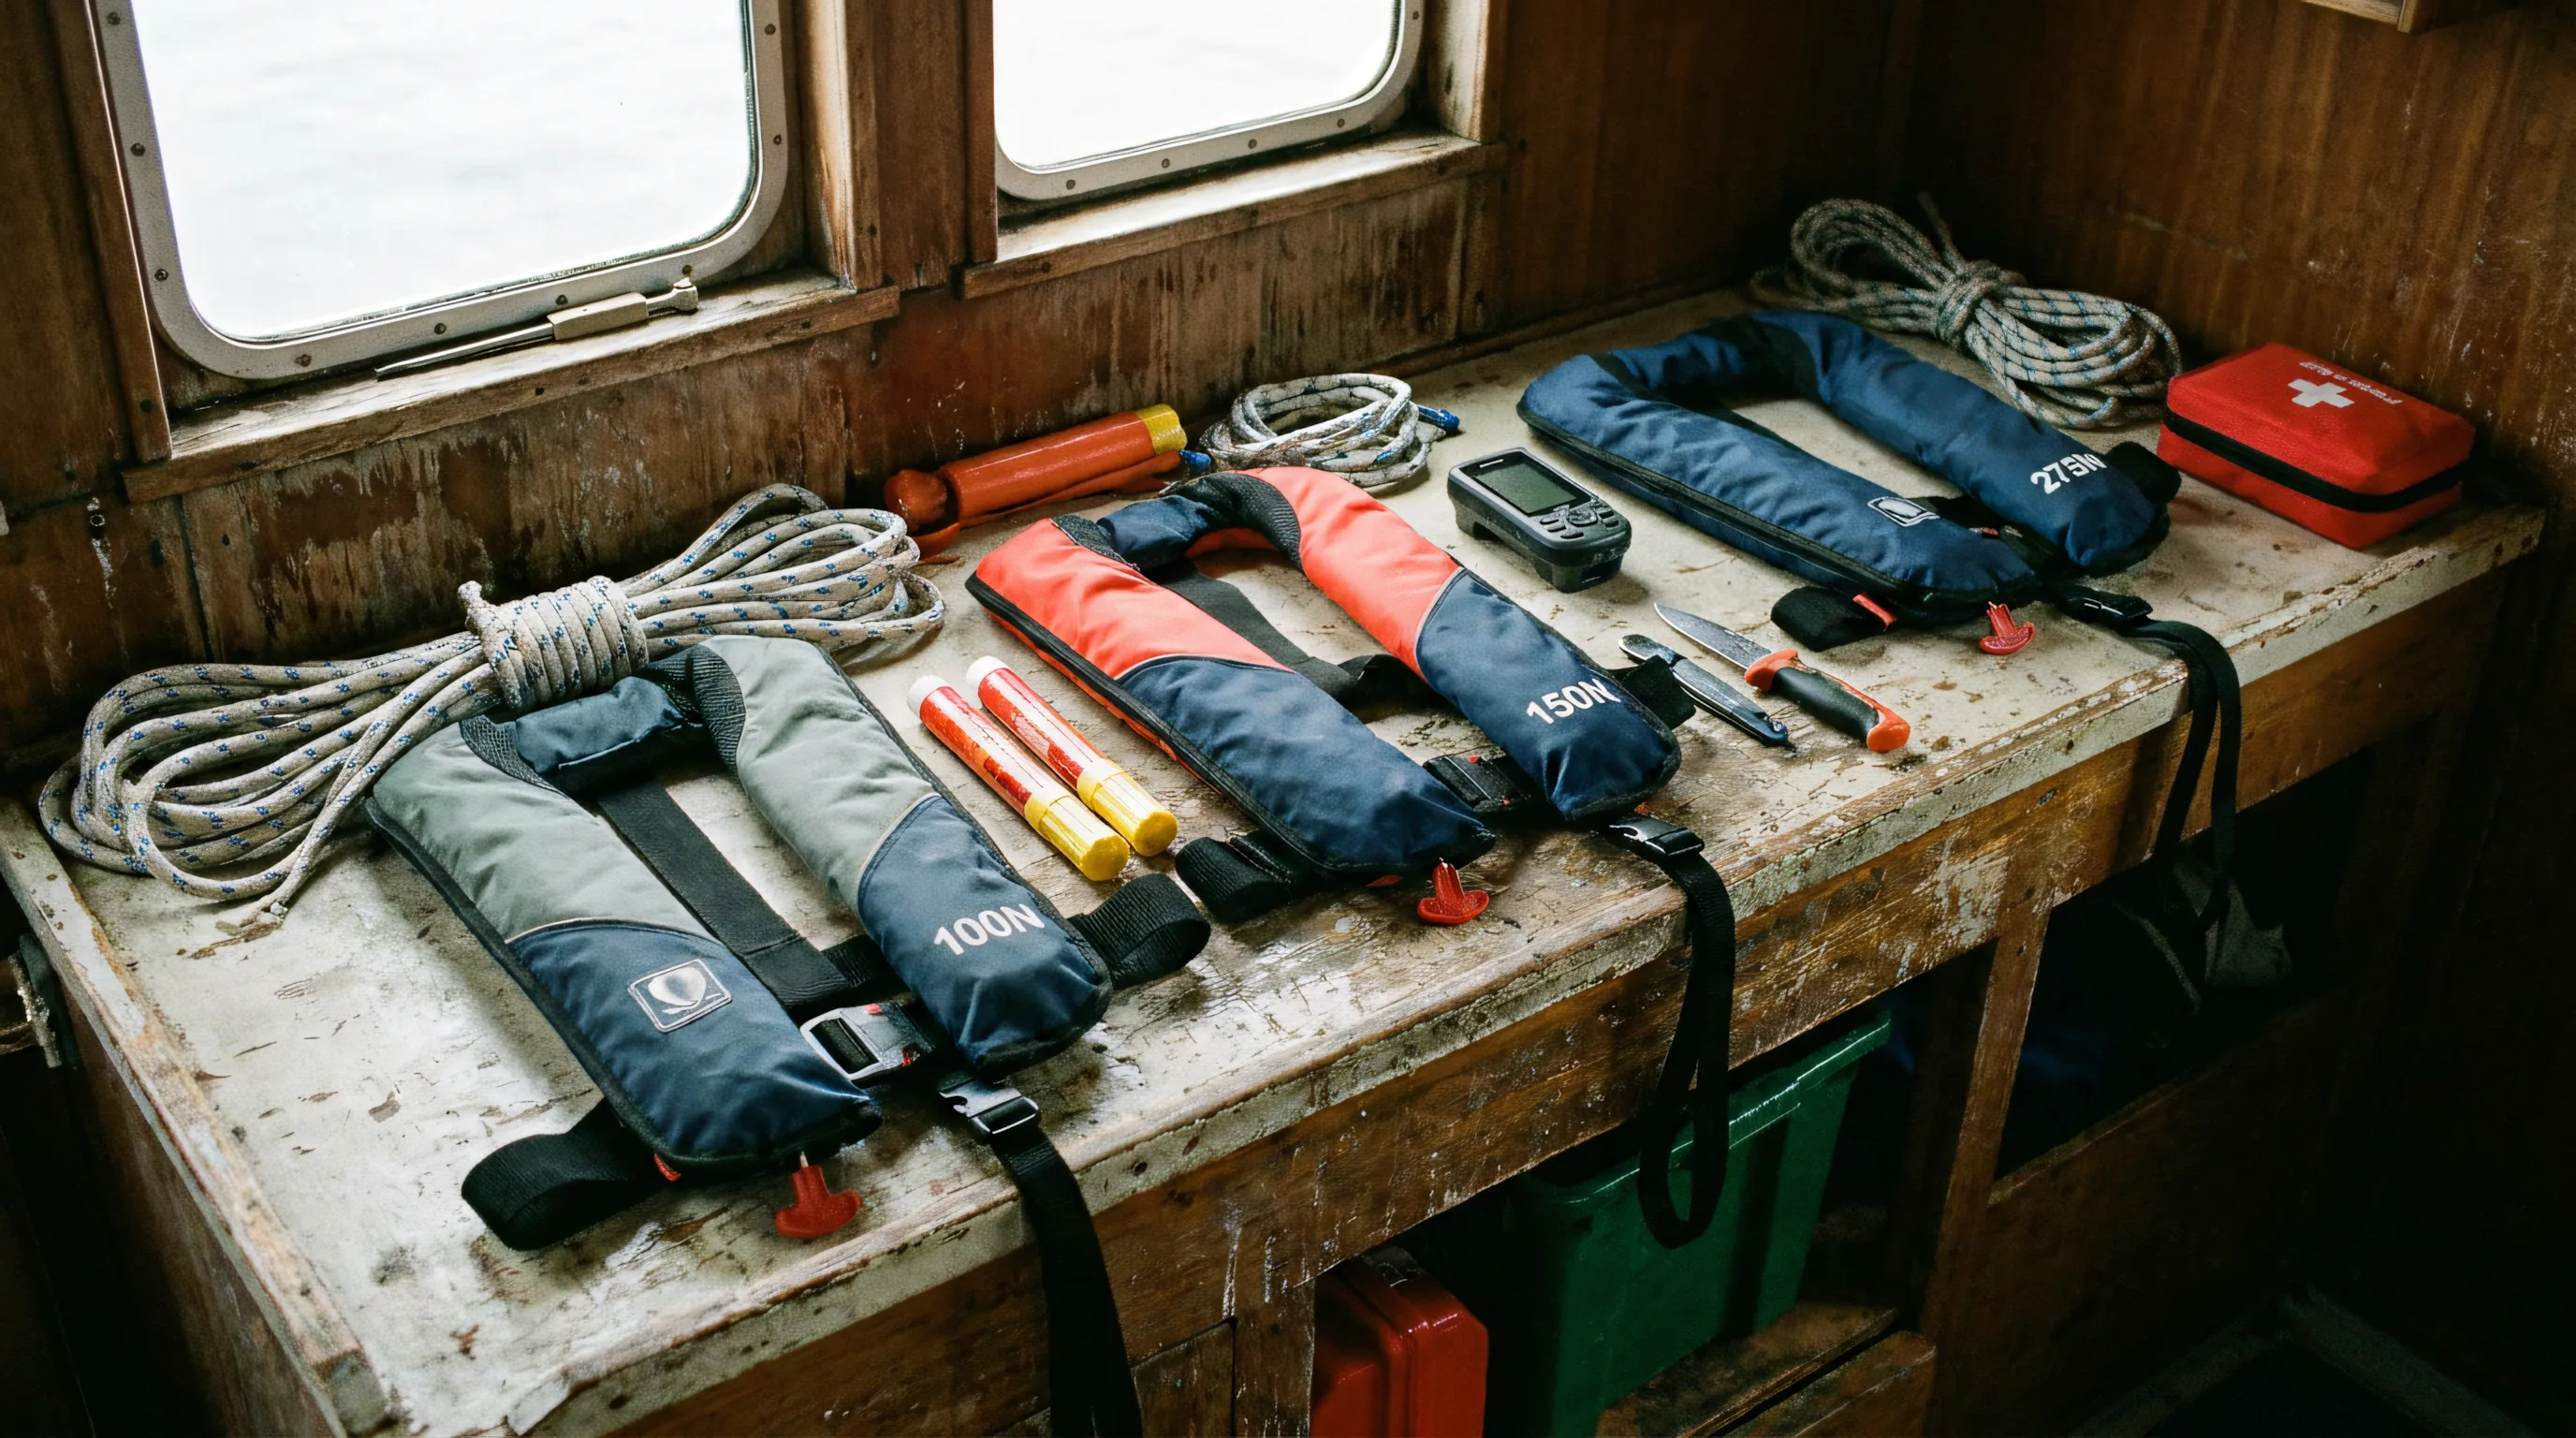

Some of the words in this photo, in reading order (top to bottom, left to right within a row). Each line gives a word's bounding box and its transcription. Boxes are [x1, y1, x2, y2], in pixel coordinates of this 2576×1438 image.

[2030, 453, 2107, 494] 275N
[1526, 678, 1621, 724] 150N
[933, 903, 1046, 956] 100N
